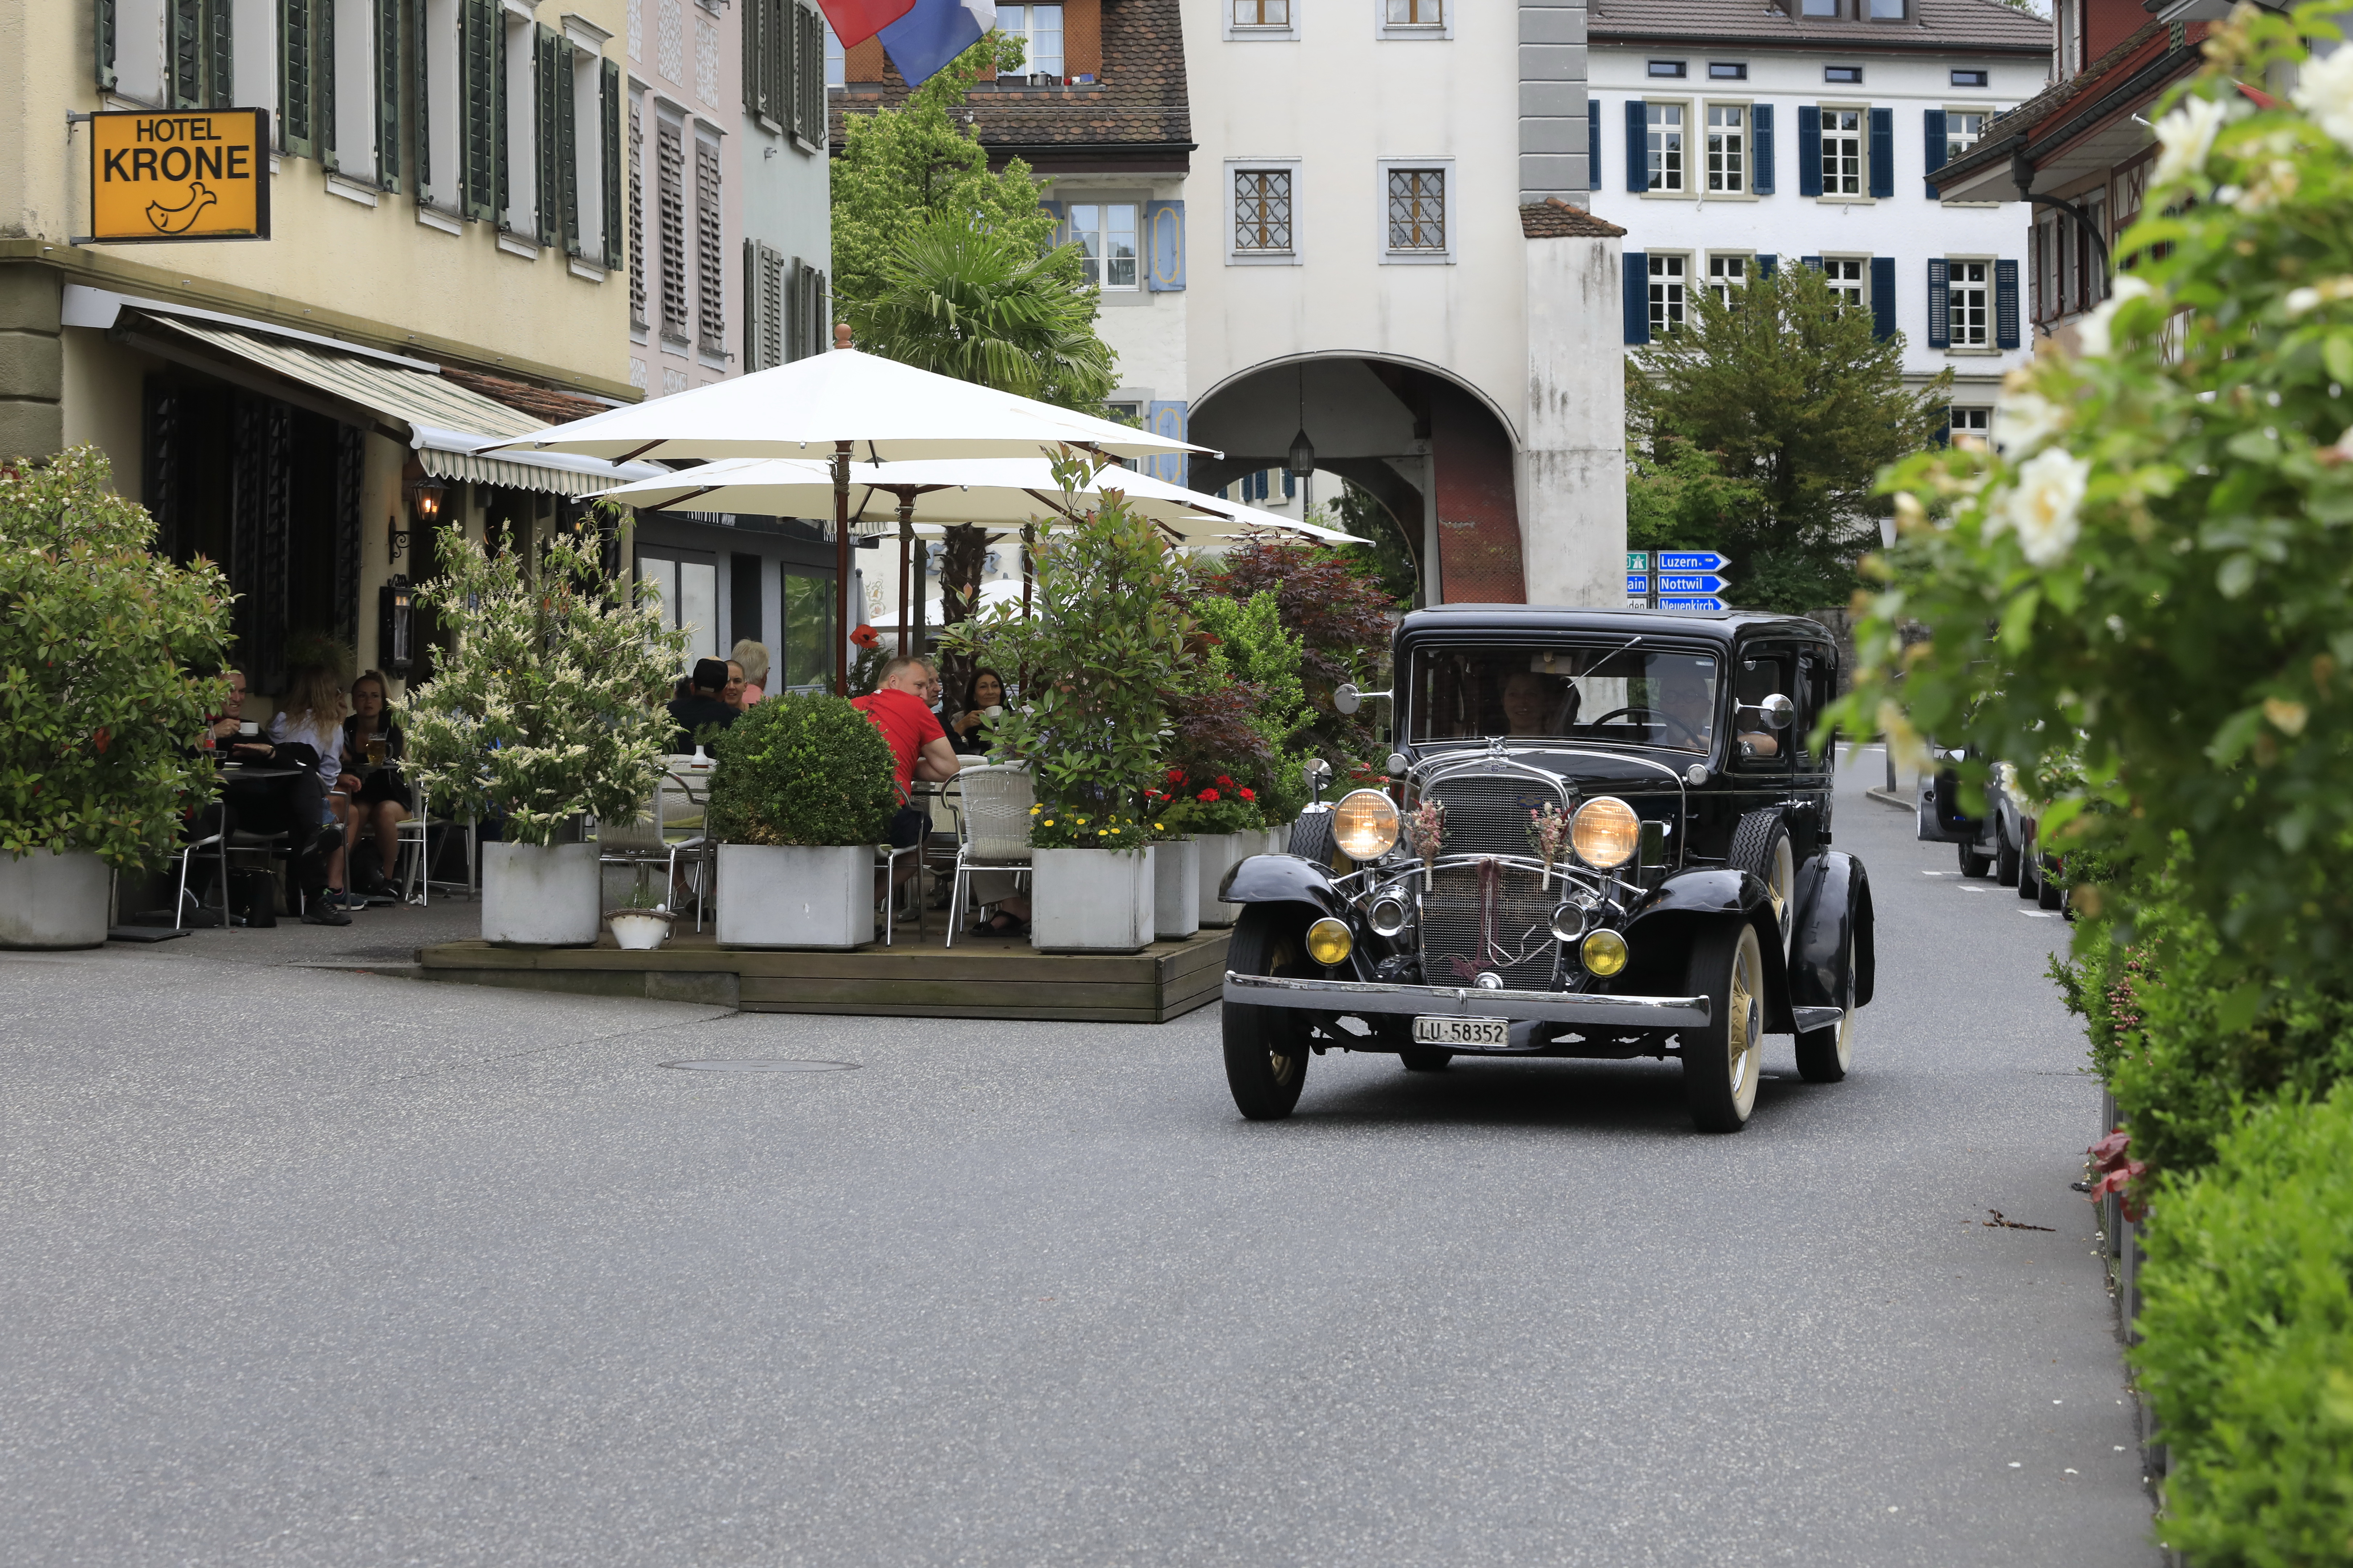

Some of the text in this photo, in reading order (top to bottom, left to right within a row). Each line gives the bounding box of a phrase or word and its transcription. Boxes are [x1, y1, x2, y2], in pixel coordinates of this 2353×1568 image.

[136, 118, 221, 142] HOTEL
[104, 145, 249, 182] KRONE
[1661, 555, 1697, 567] Luzern
[1627, 577, 1644, 589] ain
[1661, 577, 1702, 589] Nottwil
[1627, 600, 1644, 609] den
[1661, 599, 1713, 610] Neuenkirch
